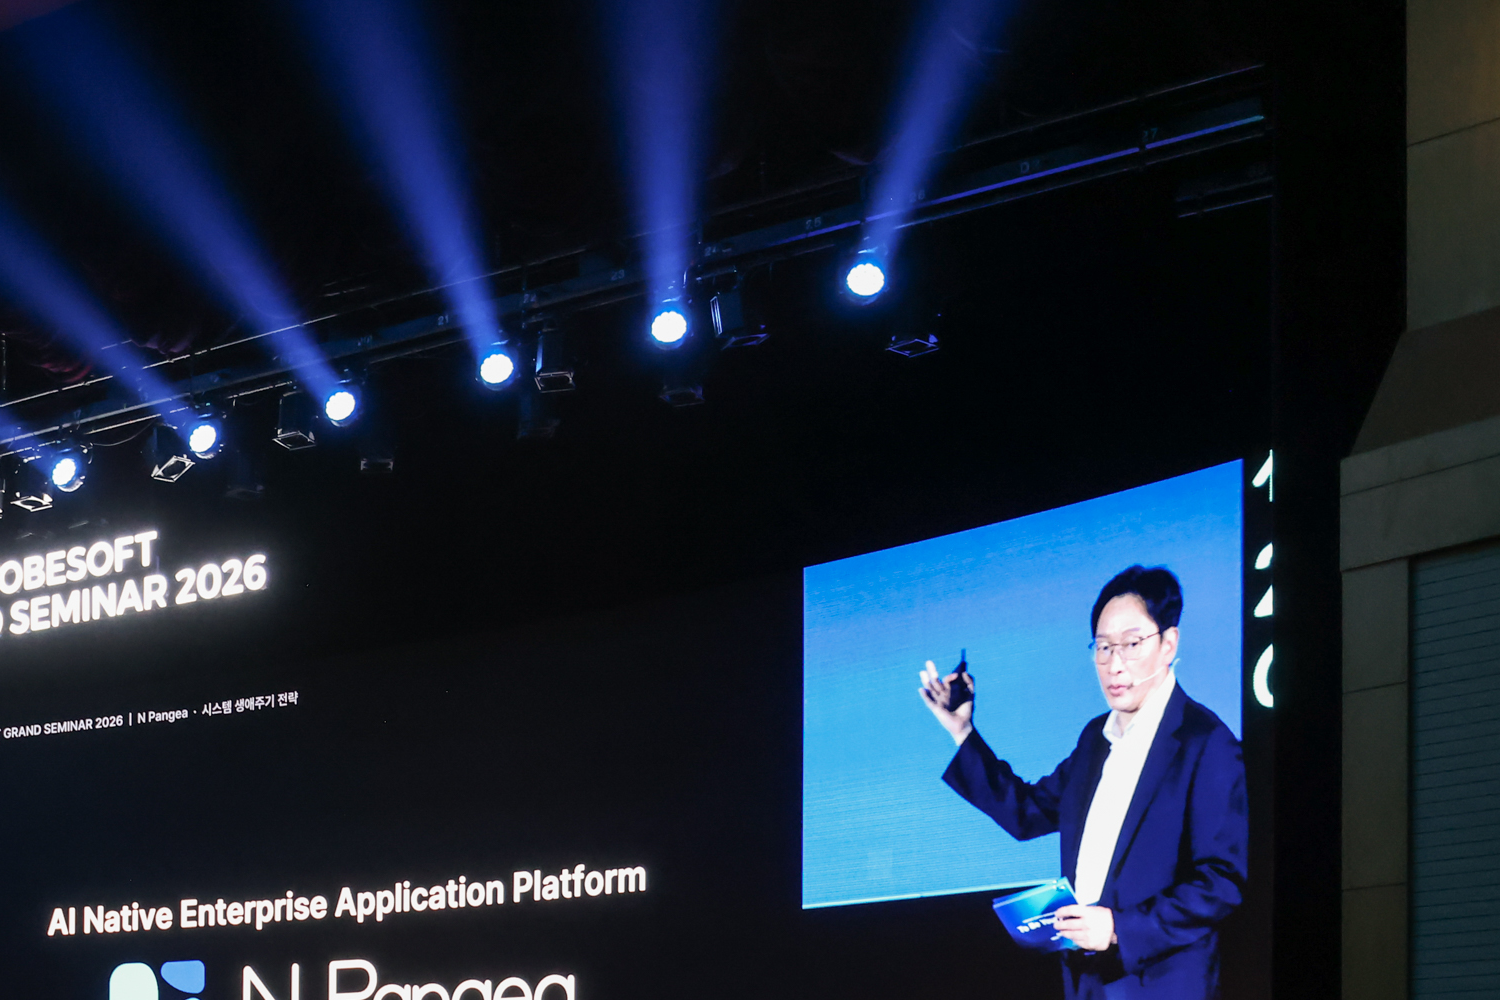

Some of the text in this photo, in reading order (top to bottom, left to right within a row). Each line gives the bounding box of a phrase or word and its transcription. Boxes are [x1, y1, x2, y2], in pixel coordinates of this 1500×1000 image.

[9, 574, 167, 634] SEMINAR
[174, 554, 267, 605] 2026
[3, 724, 41, 739] GRAND
[43, 719, 93, 735] SEMINAR
[95, 714, 123, 729] 2026
[137, 711, 147, 724] N
[148, 709, 188, 723] Pangea
[201, 700, 232, 716] 시스템
[234, 693, 275, 713] 생애주기
[277, 691, 298, 706] 전략
[47, 865, 647, 936] AI Native Enterprise Application Platform
